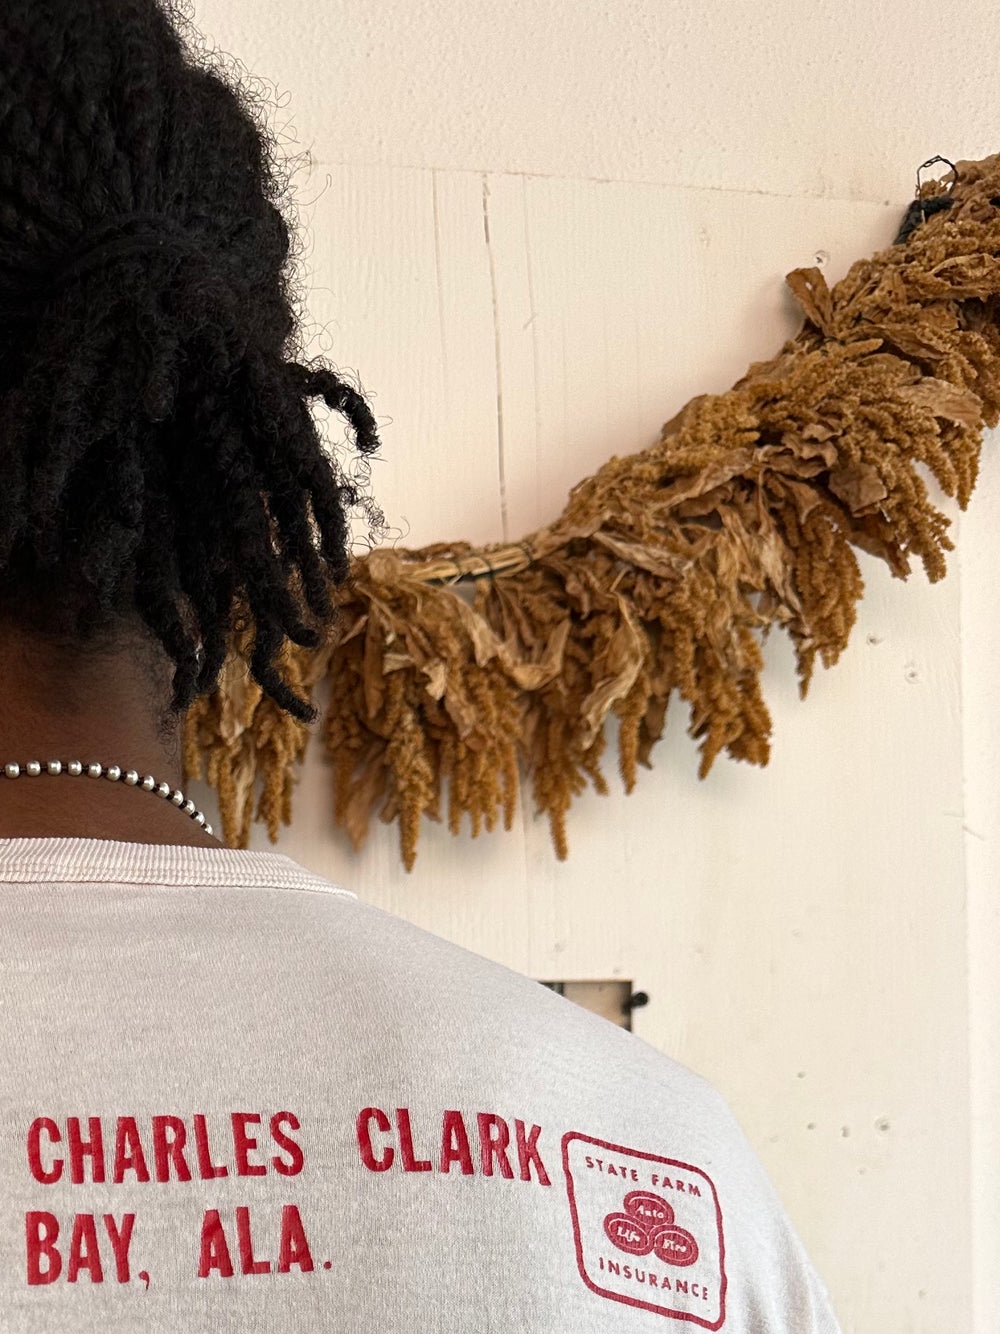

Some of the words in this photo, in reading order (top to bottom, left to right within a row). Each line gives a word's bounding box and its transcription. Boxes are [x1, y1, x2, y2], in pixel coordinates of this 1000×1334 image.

[25, 1110, 305, 1186] CHARLES
[355, 1106, 552, 1187] CLARK
[584, 1155, 640, 1182] STATE
[651, 1173, 702, 1198] FARM
[635, 1204, 666, 1220] Auto
[24, 1210, 151, 1290] BAY,
[196, 1203, 334, 1279] ALA.
[615, 1225, 643, 1244] Life
[661, 1238, 688, 1254] Fire
[598, 1256, 709, 1301] INSURANCE
